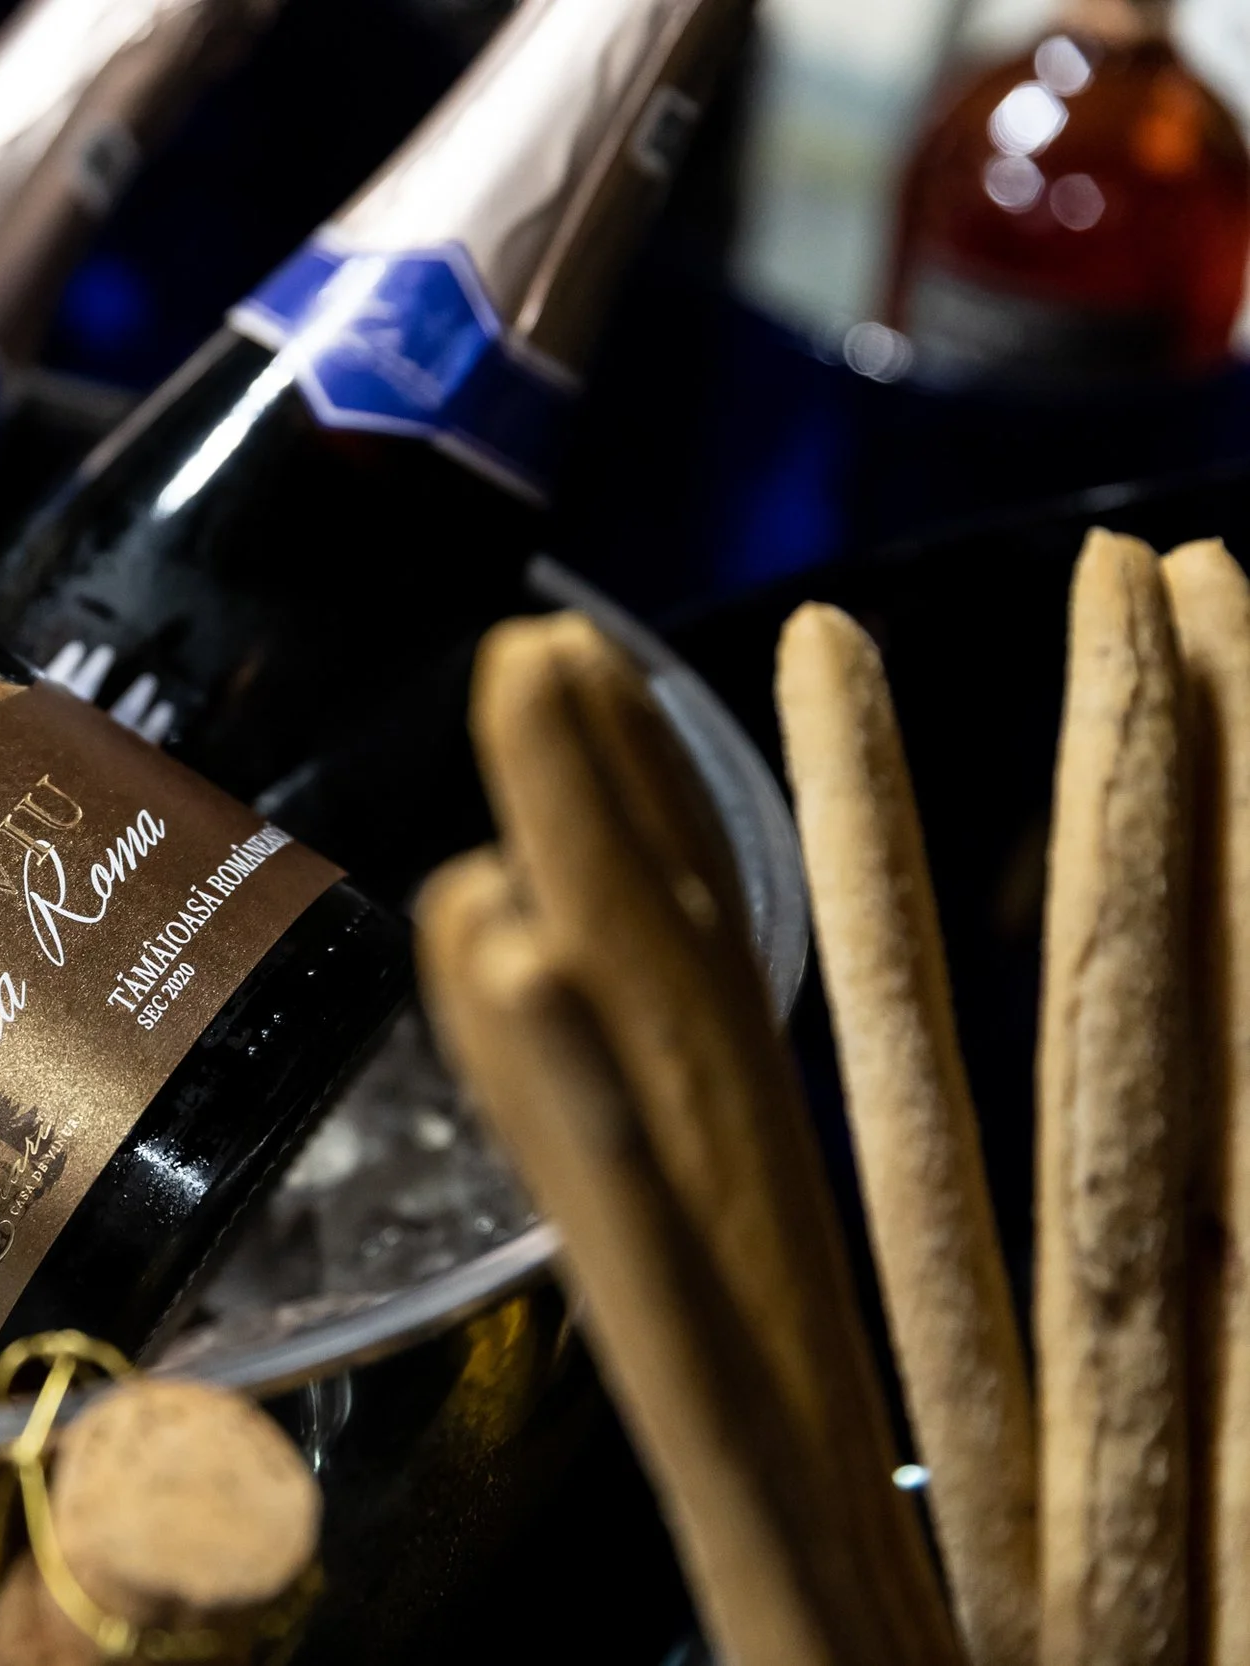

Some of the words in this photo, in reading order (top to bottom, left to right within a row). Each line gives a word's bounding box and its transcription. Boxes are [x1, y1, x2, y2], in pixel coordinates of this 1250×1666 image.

[23, 808, 166, 967] Roma
[137, 994, 170, 1031] SEC
[163, 962, 196, 1001] 2020
[10, 1183, 36, 1217] CASA
